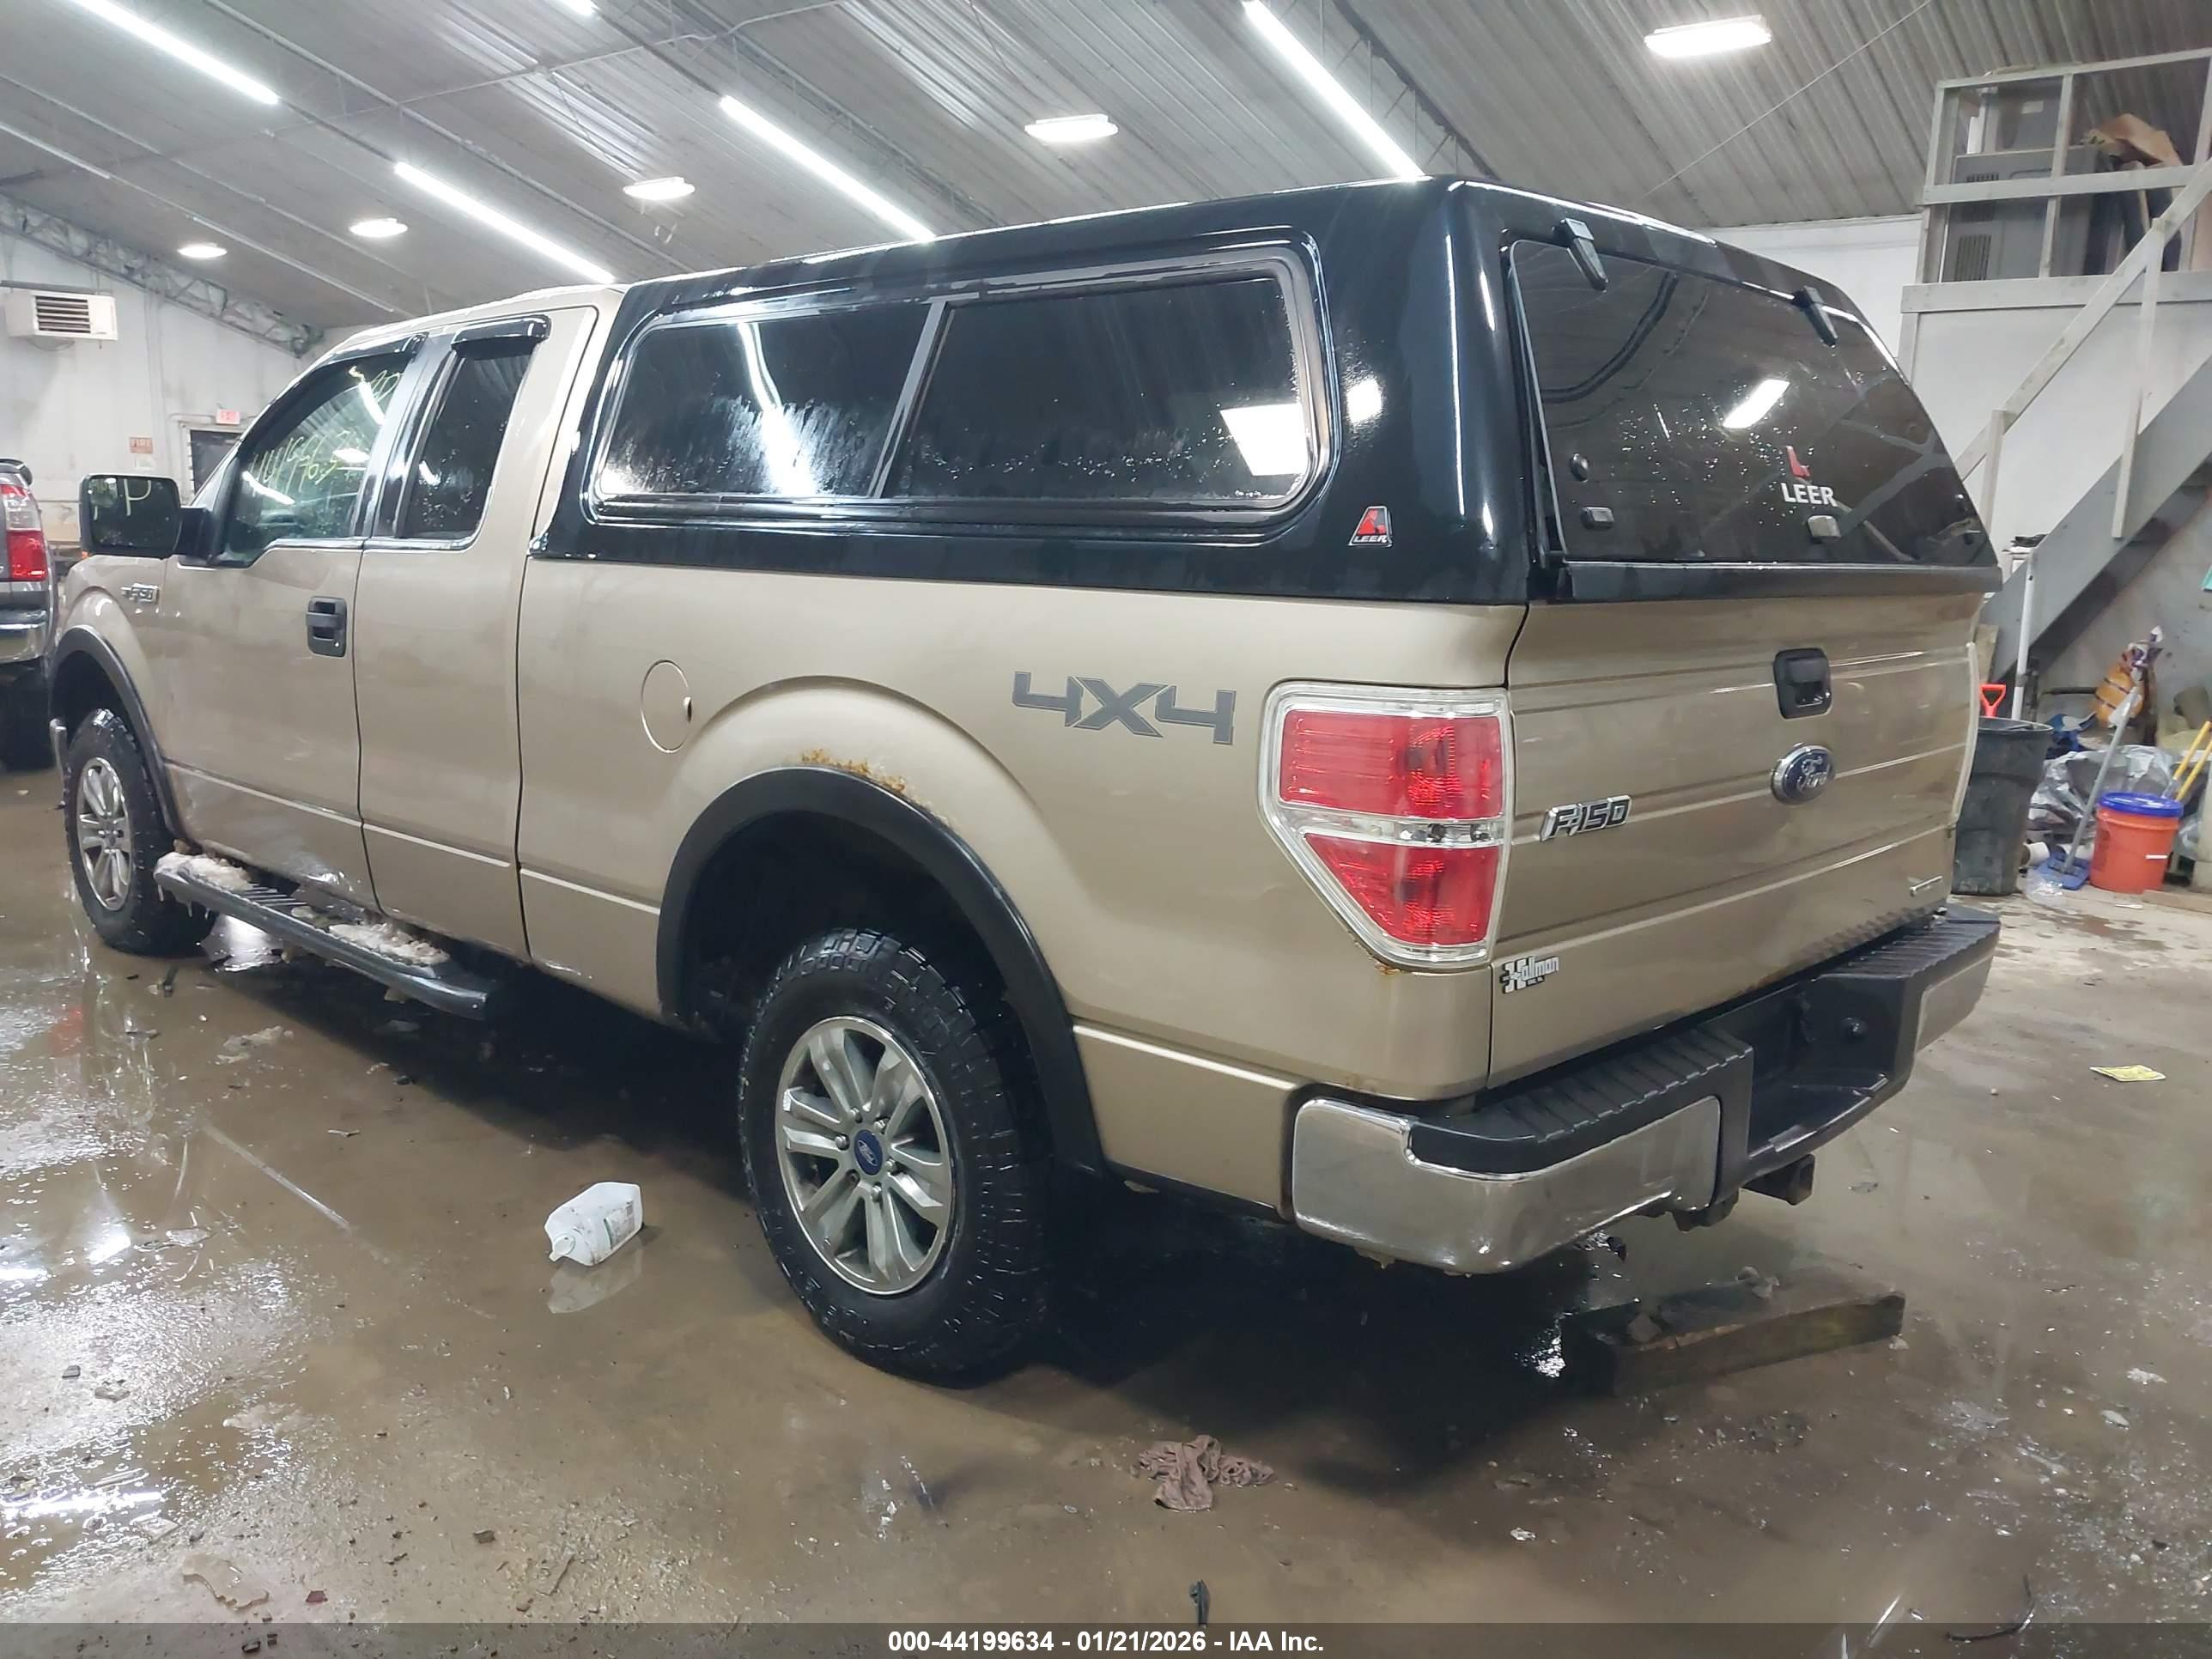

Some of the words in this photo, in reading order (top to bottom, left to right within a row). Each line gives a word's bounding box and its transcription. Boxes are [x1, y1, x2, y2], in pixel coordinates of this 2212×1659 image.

[1780, 482, 1838, 507] LEER
[1352, 534, 1389, 544] LEER
[1796, 756, 1828, 790] Ford
